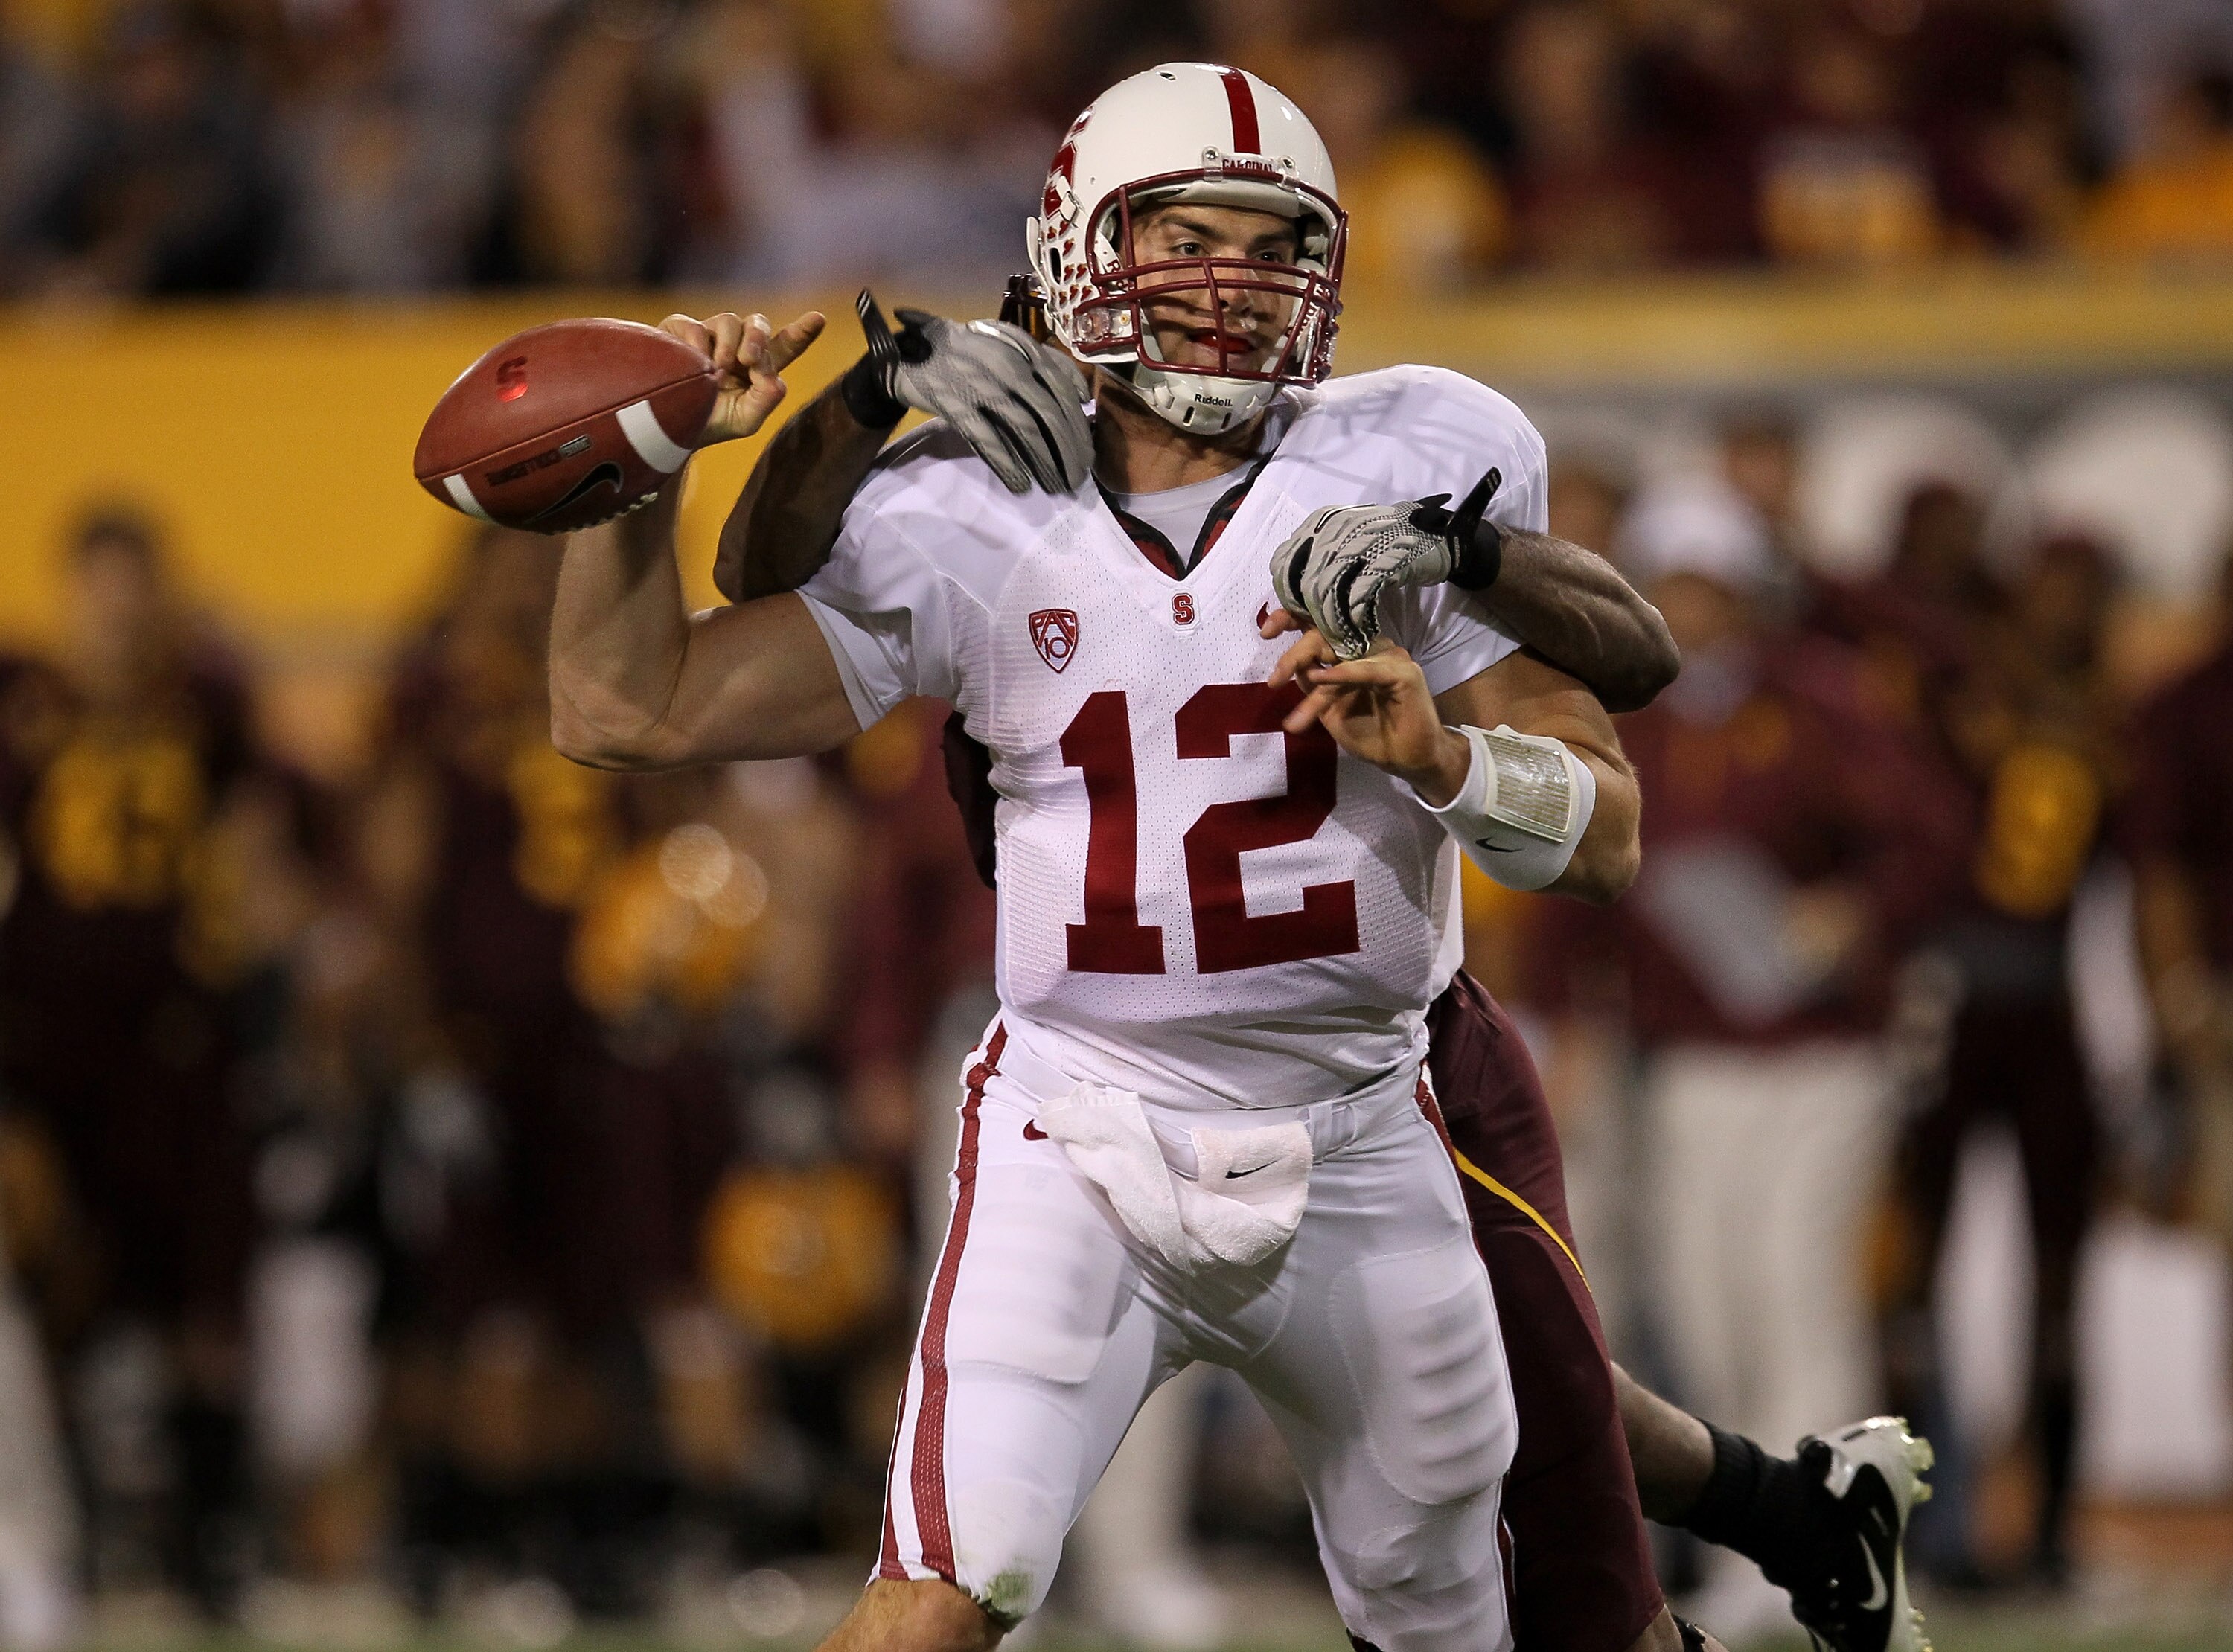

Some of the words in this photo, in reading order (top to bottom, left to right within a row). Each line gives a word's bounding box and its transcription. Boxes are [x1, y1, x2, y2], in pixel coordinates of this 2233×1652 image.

[496, 356, 528, 402] S
[1194, 394, 1233, 407] Riddell
[1172, 593, 1195, 625] S
[1031, 612, 1076, 647] PAC
[1044, 637, 1070, 659] 10
[1058, 679, 1360, 973] 12
